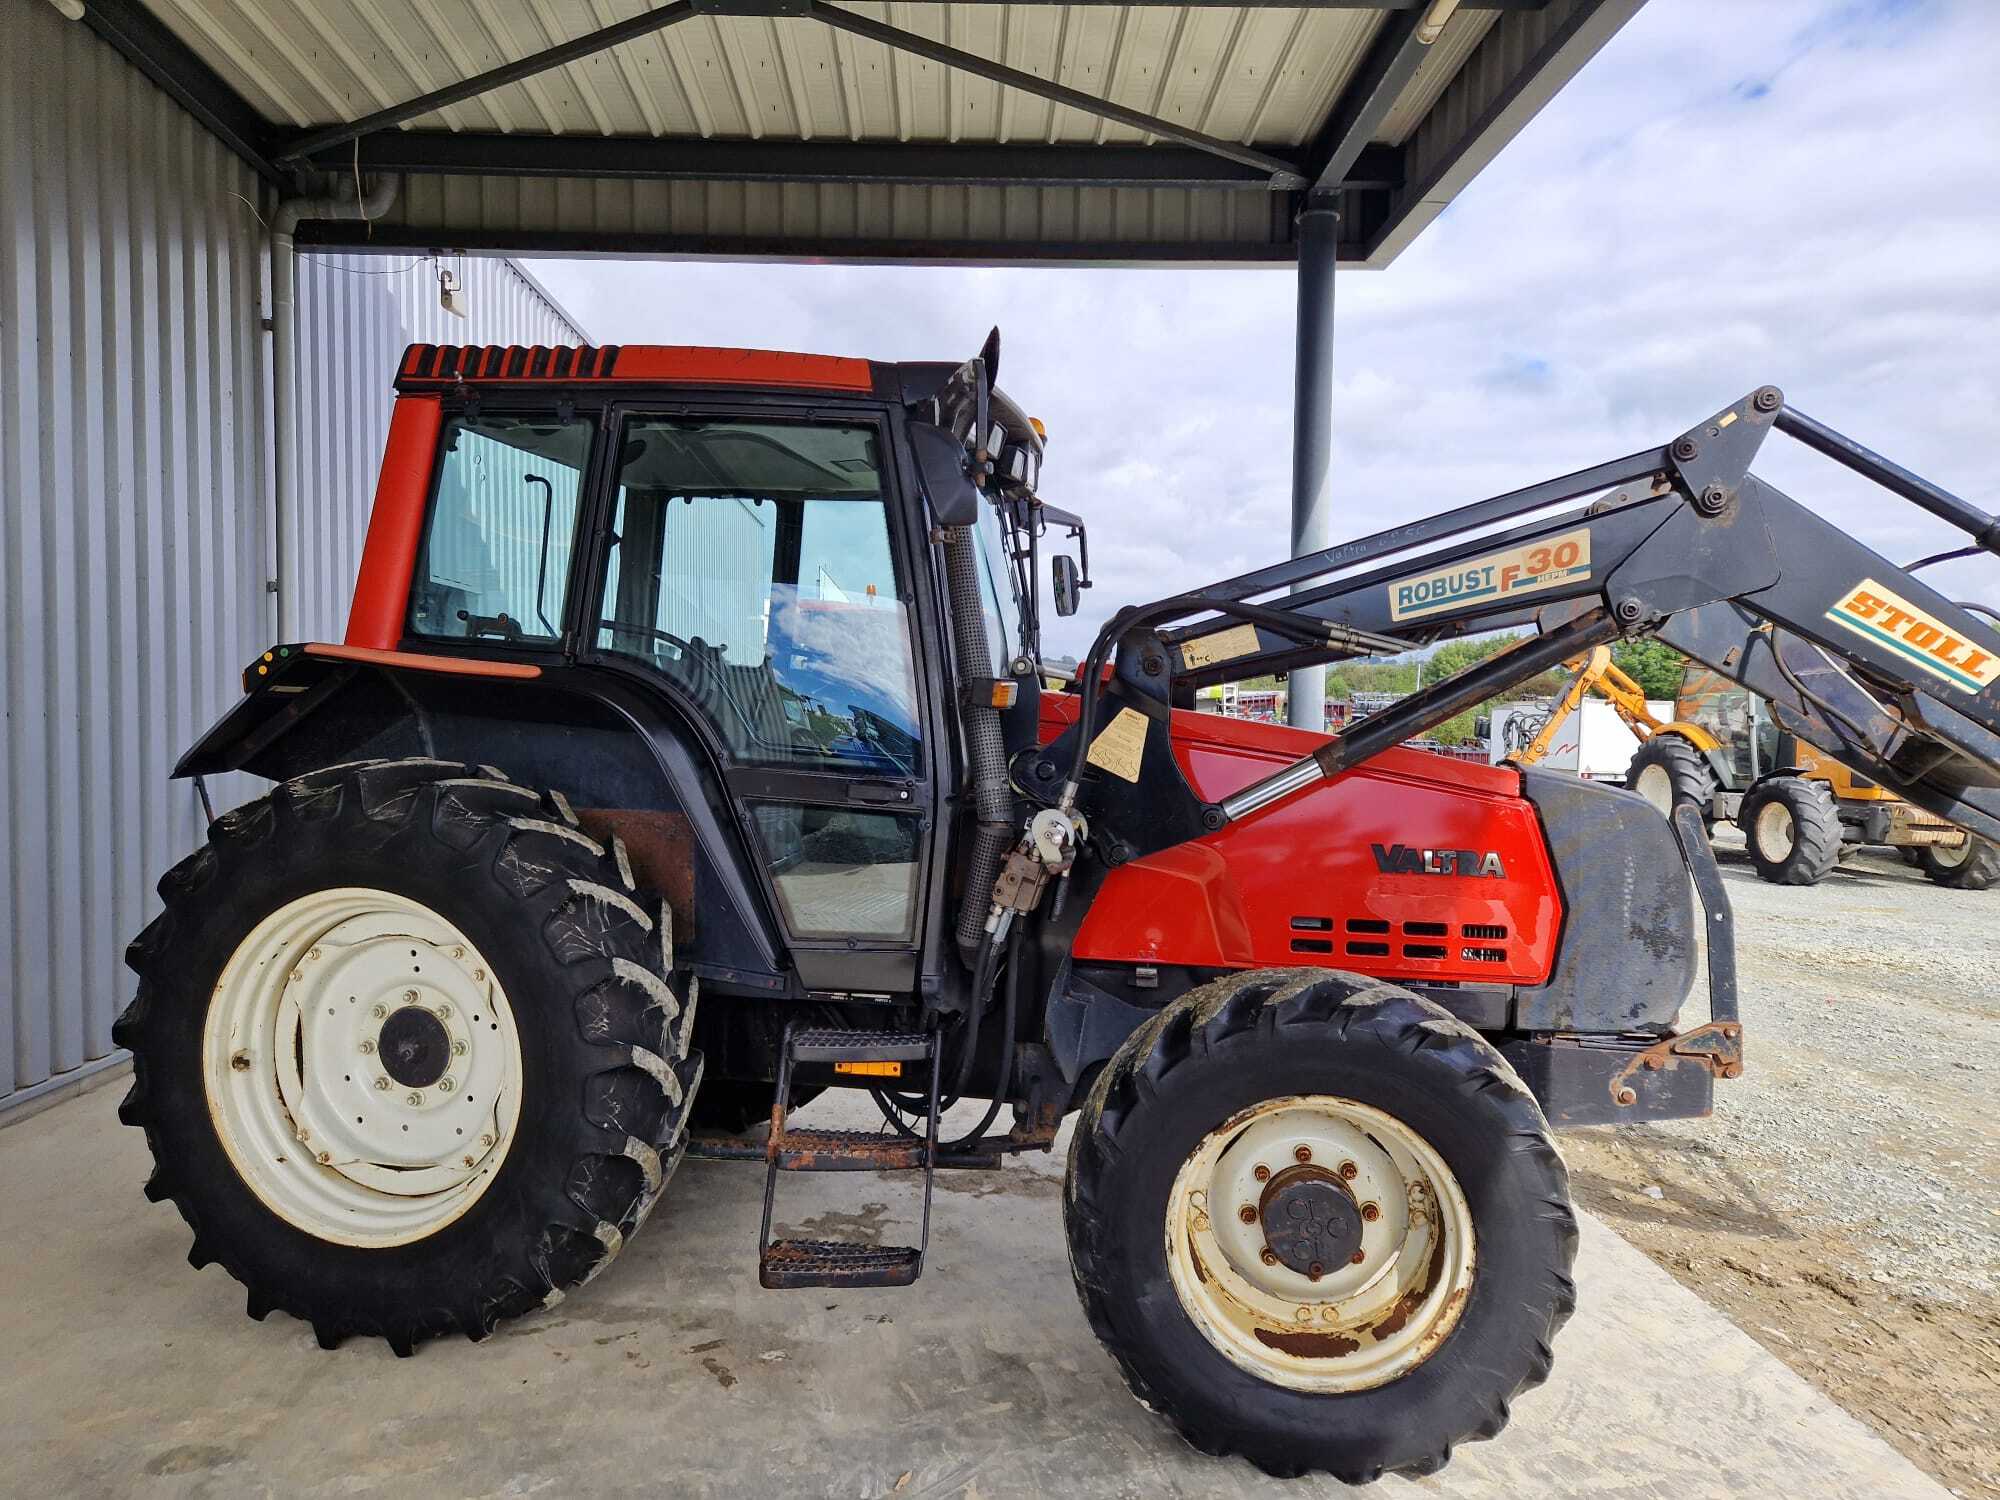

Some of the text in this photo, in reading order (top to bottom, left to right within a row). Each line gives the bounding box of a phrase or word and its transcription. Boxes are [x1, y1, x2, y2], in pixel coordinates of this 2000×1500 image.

[1398, 541, 1580, 608] ROBUST F 30
[1844, 591, 1992, 679] STOLL
[1370, 843, 1507, 879] VALTRA
